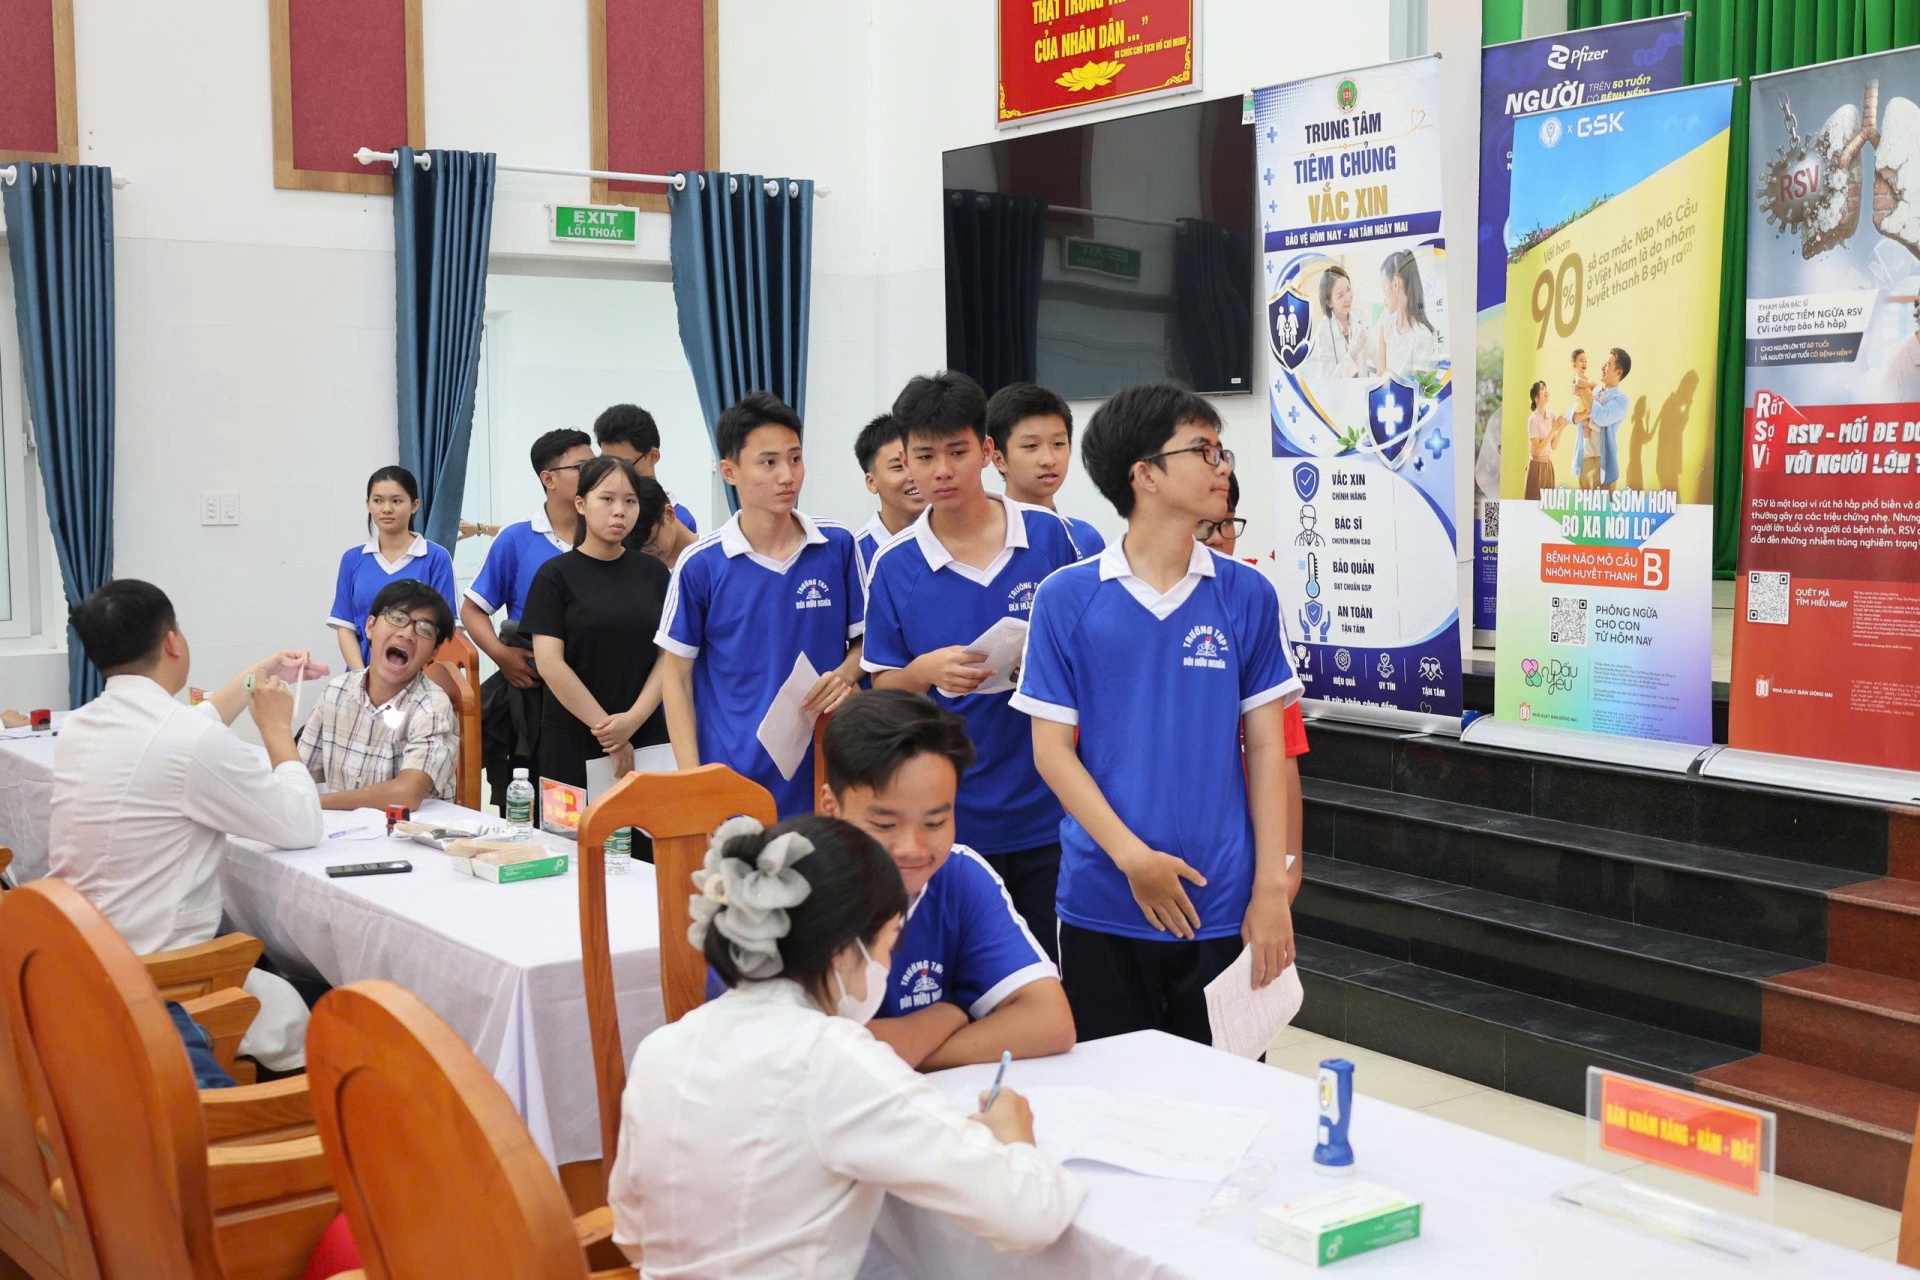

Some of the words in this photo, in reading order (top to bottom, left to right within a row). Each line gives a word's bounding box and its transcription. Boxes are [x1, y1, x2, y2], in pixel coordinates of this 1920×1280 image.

[1034, 30, 1058, 63] CỦA
[1061, 25, 1096, 57] NHÂN
[1099, 18, 1124, 49] DÂN
[1164, 38, 1172, 49] CHÍ
[1570, 45, 1608, 70] Pfizer
[1589, 81, 1610, 92] TRÊN
[1612, 80, 1624, 88] 50
[1504, 80, 1586, 114] NGƯỜI
[1305, 118, 1349, 144] TRUNG
[1353, 111, 1382, 136] TÂM
[1578, 111, 1624, 138] GSK
[1294, 153, 1334, 184] TIÊM
[1340, 141, 1396, 178] CHỦNG
[1780, 165, 1820, 202] RSV
[1308, 182, 1349, 224] VẮC
[1355, 185, 1388, 218] XIN
[574, 210, 618, 225] EXIT
[589, 227, 623, 238] THOÁT
[1285, 232, 1298, 246] BẢO
[1300, 232, 1308, 246] VỆ
[1310, 230, 1325, 243] HÔM
[1327, 230, 1342, 241] NAY
[1349, 228, 1358, 238] AN
[1360, 224, 1374, 238] TÂM
[1374, 222, 1392, 236] NGÀY
[1394, 221, 1408, 233] MAI
[1588, 252, 1597, 272] số
[1599, 252, 1610, 266] ca
[1612, 234, 1632, 258] mắc
[1636, 227, 1654, 246] Não
[1656, 212, 1672, 234] Mô
[1676, 198, 1698, 222] Cầu
[1594, 266, 1612, 286] Việt
[1614, 256, 1636, 277] Nam
[1639, 247, 1648, 266] là
[1650, 241, 1662, 258] do
[1664, 224, 1696, 250] nhóm
[1587, 282, 1610, 308] huyết
[1612, 272, 1640, 295] thanh
[1650, 257, 1670, 280] gây
[1758, 312, 1770, 323] ĐỂ
[1772, 312, 1795, 323] ĐƯỢC
[1796, 308, 1814, 320] TIÊM
[1818, 308, 1845, 318] NGỪA
[1846, 308, 1862, 316] RSV
[1783, 325, 1796, 334] hợp
[1798, 322, 1812, 330] bào
[1814, 320, 1824, 328] hô
[1827, 318, 1847, 330] hấp)
[1787, 424, 1824, 444] RSV
[1838, 416, 1868, 443] MỐI
[1872, 422, 1899, 442] ĐE
[1785, 450, 1815, 474] VỚI
[1816, 449, 1868, 474] NGƯỜI
[1872, 449, 1911, 474] LỚN
[1332, 470, 1348, 486] VẮC
[1350, 474, 1366, 486] XIN
[1332, 490, 1348, 500] CHÍNH
[1540, 485, 1572, 510] XUẤT
[1574, 486, 1608, 512] PHÁT
[1612, 487, 1646, 512] SỚM
[1648, 489, 1676, 514] HƠN
[1752, 500, 1768, 508] RSV
[1769, 499, 1776, 508] là
[1777, 499, 1791, 509] một
[1792, 500, 1808, 510] loại
[1819, 500, 1831, 508] rút
[1832, 500, 1842, 508] hô
[1844, 499, 1860, 510] hấp
[1862, 498, 1878, 510] phổ
[1881, 498, 1901, 508] biến
[1903, 500, 1914, 508] và
[1334, 516, 1350, 530] BÁC
[1354, 516, 1362, 530] SĨ
[1562, 512, 1580, 537] BỎ
[1583, 516, 1600, 538] XA
[1605, 513, 1630, 539] NỖI
[1752, 512, 1778, 522] thường
[1779, 512, 1792, 522] gây
[1804, 512, 1821, 520] các
[1824, 512, 1842, 522] triệu
[1843, 512, 1869, 523] chứng
[1871, 512, 1890, 523] nhẹ.
[1751, 524, 1772, 533] người
[1786, 522, 1801, 532] tuổi
[1803, 524, 1814, 532] và
[1816, 524, 1840, 536] người
[1842, 524, 1852, 533] có
[1854, 525, 1874, 535] bệnh
[1877, 524, 1896, 536] nền,
[1899, 526, 1916, 534] RSV
[1751, 534, 1766, 544] dẫn
[1767, 534, 1780, 544] đến
[1781, 536, 1806, 546] những
[1810, 534, 1835, 546] nhiễm
[1837, 538, 1858, 548] trùng
[1860, 538, 1893, 549] nghiêm
[1333, 558, 1348, 573] BẢO
[1351, 559, 1374, 575] QUẢN
[1546, 550, 1570, 564] BỆNH
[1573, 552, 1594, 564] NÃO
[1597, 553, 1613, 566] MÔ
[1616, 552, 1638, 567] CẦU
[1546, 566, 1570, 577] NHÓM
[1574, 566, 1602, 579] HUYẾT
[1604, 571, 1637, 582] THANH
[1644, 552, 1662, 587] B
[1008, 582, 1032, 600] TRƯỜNG
[1796, 588, 1817, 596] QUÉT
[1008, 602, 1020, 612] BÙI
[1795, 597, 1809, 606] TÌM
[1811, 596, 1828, 606] HIỂU
[1338, 606, 1348, 618] AN
[1350, 604, 1372, 618] TOÀN
[1596, 604, 1630, 616] PHÒNG
[1632, 607, 1658, 619] NGỪA
[1341, 623, 1352, 634] TẬN
[1353, 624, 1365, 634] TÂM
[1595, 619, 1616, 630] CHO
[1618, 620, 1640, 631] CON
[1183, 625, 1212, 648] TRƯỜNG
[1214, 629, 1228, 652] THPT
[1595, 630, 1608, 642] TỪ
[1610, 632, 1634, 644] HÔM
[1636, 636, 1652, 646] NAY
[1183, 656, 1194, 666] BÙI
[1194, 657, 1208, 668] HỮU
[1208, 658, 1226, 670] NGHĨA
[1379, 682, 1386, 690] UY
[1422, 686, 1432, 696] TẬN
[1433, 687, 1446, 697] TÂM
[900, 960, 929, 986] TRƯỜNG
[900, 995, 912, 1010] BÙI
[913, 992, 930, 1006] HỮU
